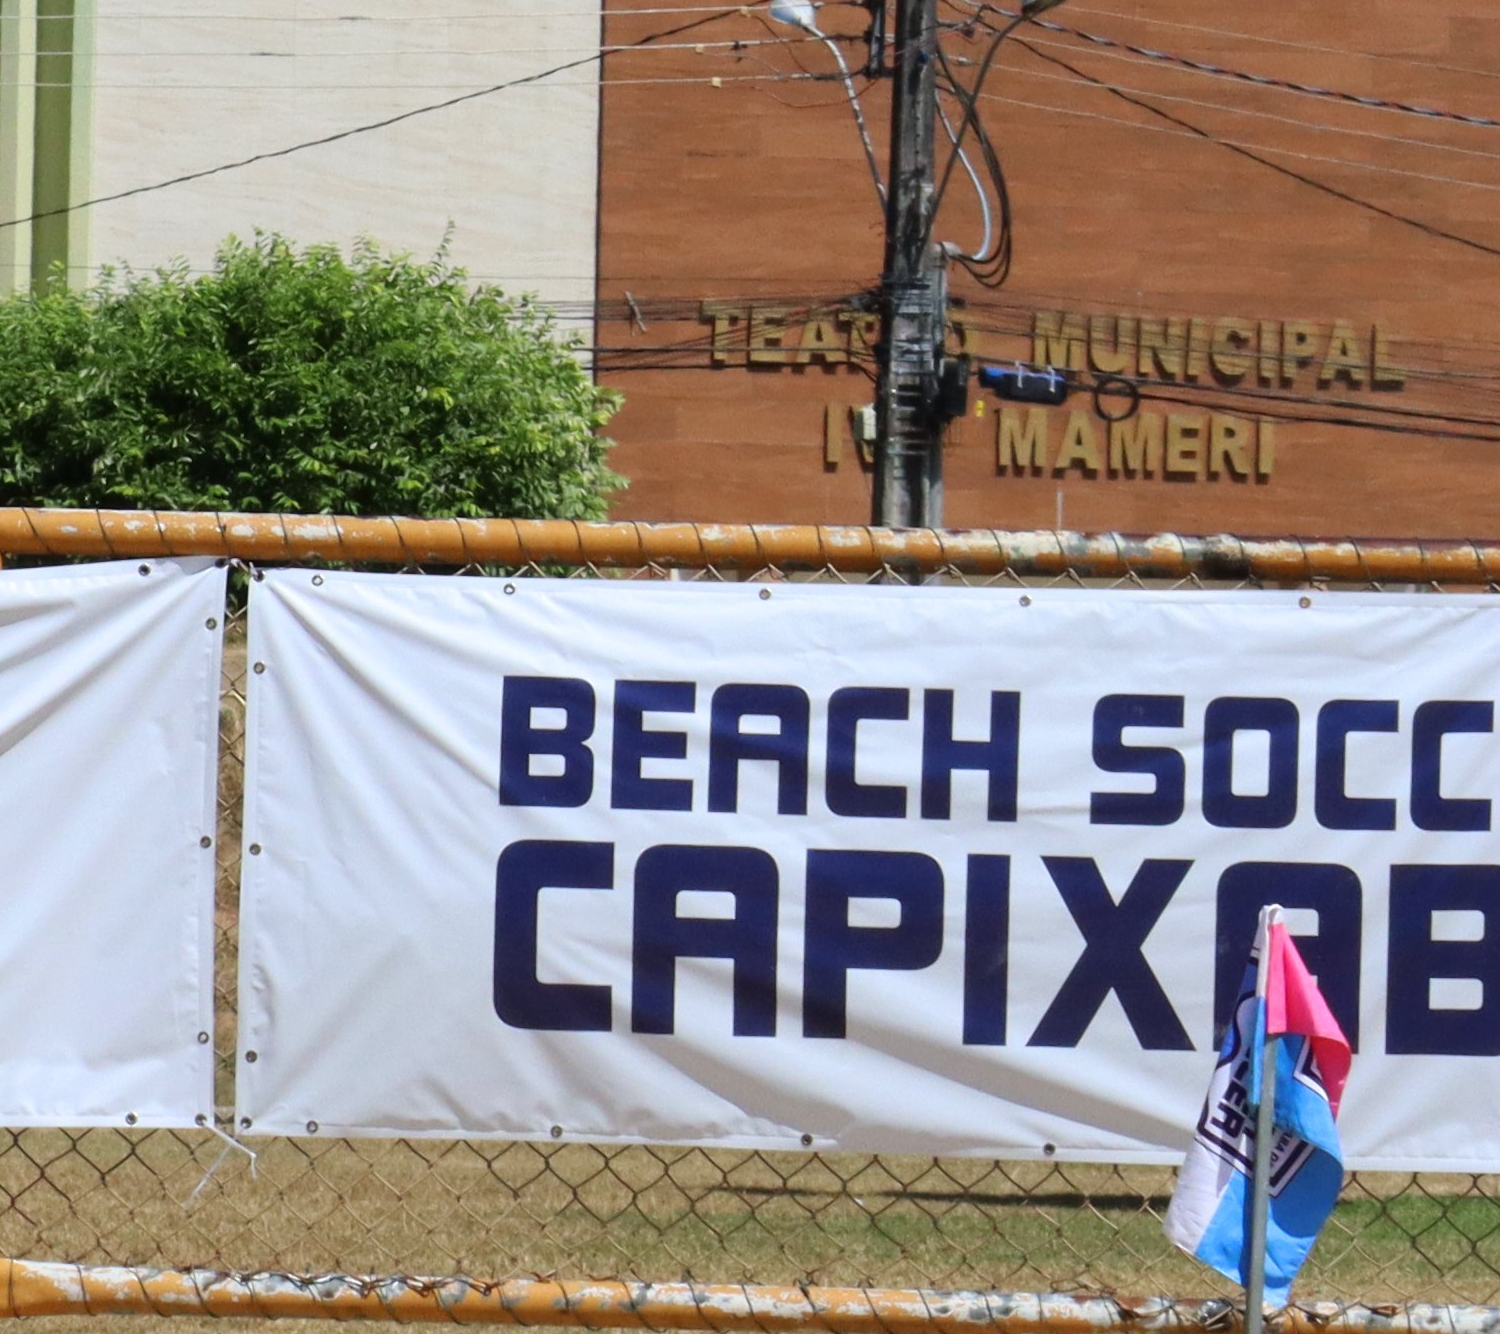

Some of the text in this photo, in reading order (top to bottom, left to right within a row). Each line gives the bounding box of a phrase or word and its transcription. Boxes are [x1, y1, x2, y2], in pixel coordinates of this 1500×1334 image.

[701, 299, 1405, 391] TEATO MUNICIPAL
[996, 407, 1276, 482] MAMERI
[499, 676, 1494, 832] BEACH SOCC
[493, 839, 1500, 1058] CAPIXAB
